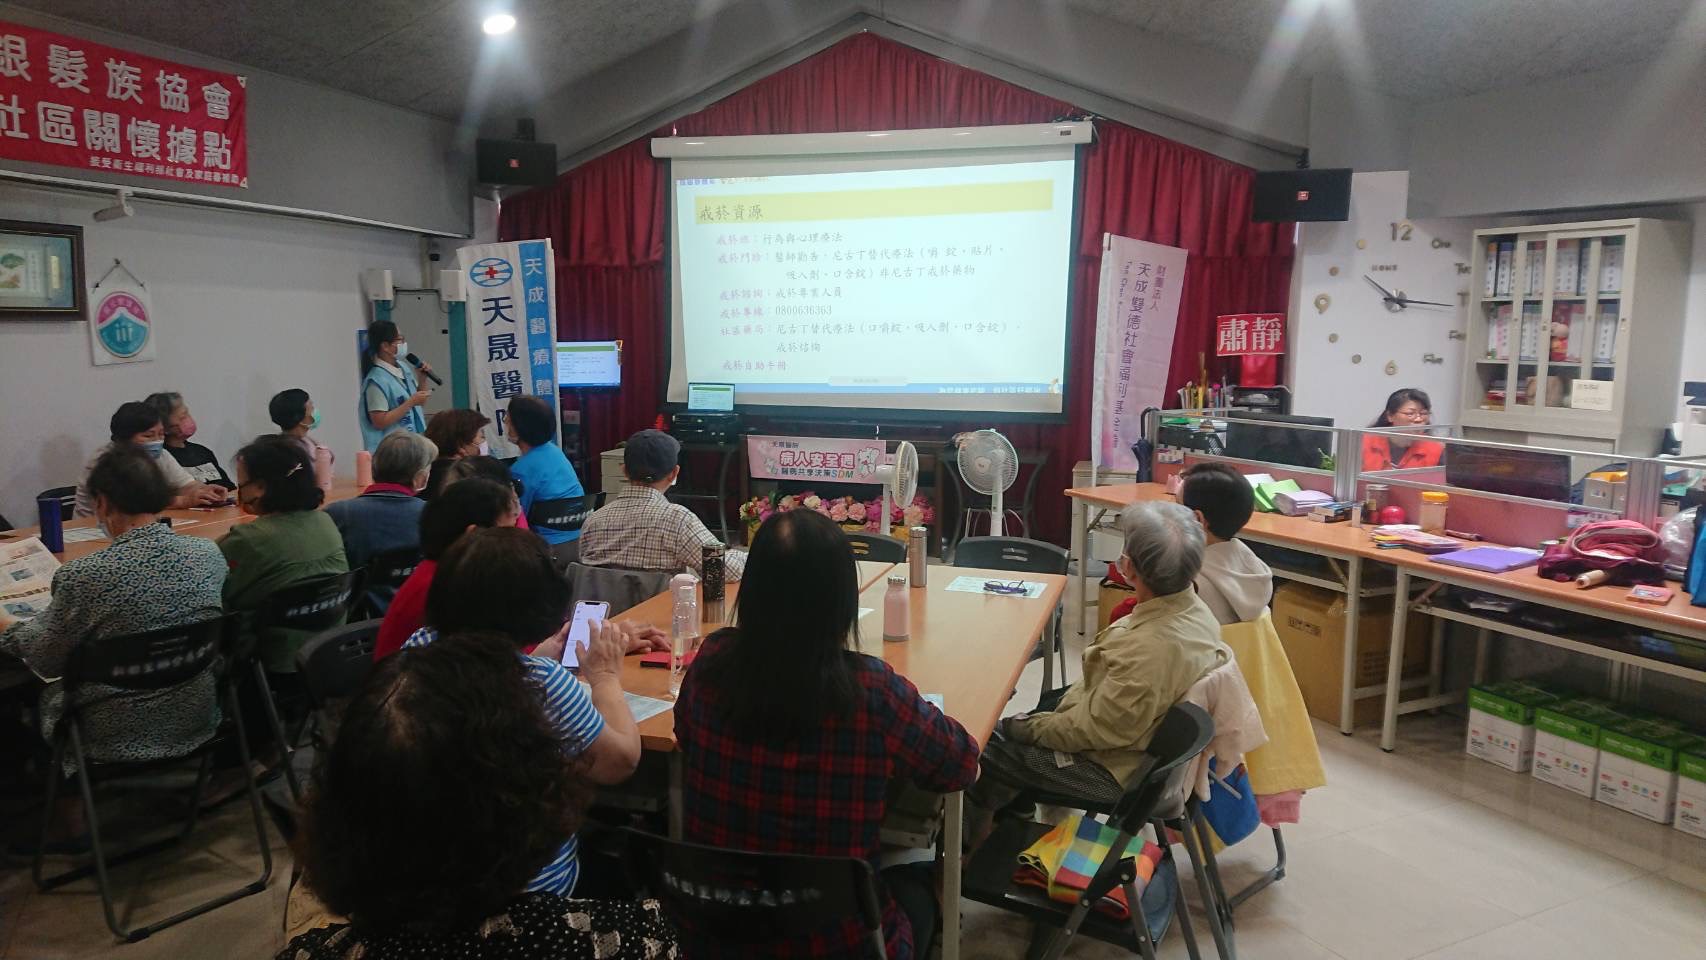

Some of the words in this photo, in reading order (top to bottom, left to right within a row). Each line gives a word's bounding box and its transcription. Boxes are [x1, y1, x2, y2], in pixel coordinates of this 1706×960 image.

[0, 93, 232, 170] 社區關懷據點
[700, 203, 763, 221] 戒菸資源
[1389, 221, 1414, 242] 12
[1219, 316, 1283, 352] 肅靜
[481, 295, 524, 437] 天晟醫
[1384, 358, 1399, 377] 6
[779, 449, 856, 469] 病人安全週
